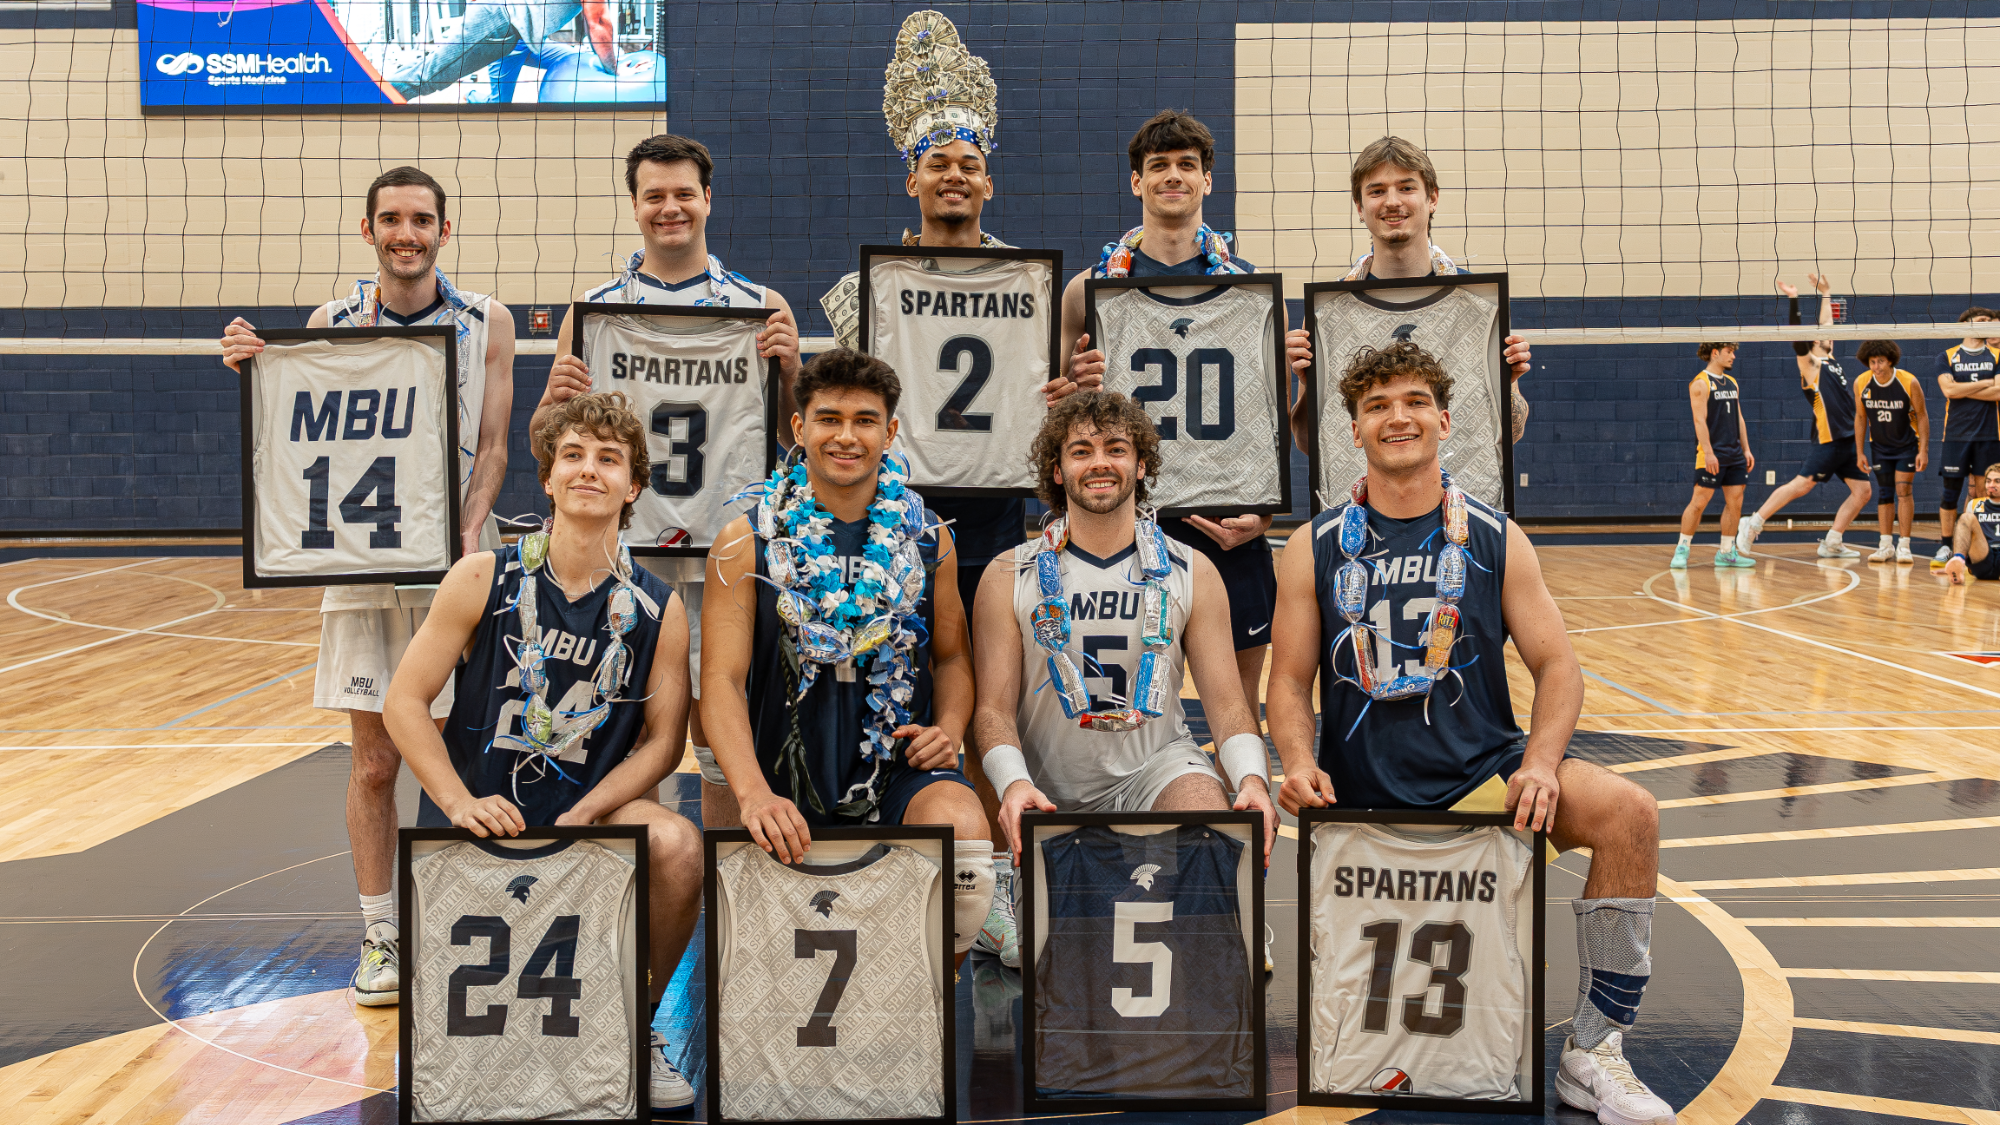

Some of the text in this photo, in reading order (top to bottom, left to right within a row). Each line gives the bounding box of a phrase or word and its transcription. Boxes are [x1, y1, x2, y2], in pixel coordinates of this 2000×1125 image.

[207, 75, 287, 86] Sports Medicine
[900, 289, 1034, 319] SPARTANS
[611, 352, 748, 386] SPARTANS
[934, 334, 994, 433] 2
[1954, 361, 1993, 372] GRACELAND
[290, 387, 416, 441] MBU
[1131, 348, 1235, 441] 20
[1453, 384, 1487, 422] SPARTAN
[1726, 401, 1731, 414] 1
[1865, 400, 1904, 409] GRACELAND
[1877, 410, 1892, 422] 20
[648, 400, 709, 498] 3
[1216, 431, 1252, 466] SPARTAN
[1226, 441, 1262, 477] SPARTAN
[301, 456, 402, 549] 14
[1371, 555, 1437, 585] MBU
[1071, 591, 1140, 620] MBU
[1438, 613, 1456, 627] RITZ
[536, 625, 597, 666] MBU
[344, 687, 379, 697] VOLLEYBALL
[351, 676, 374, 689] MBU
[1083, 635, 1128, 712] 5
[861, 860, 903, 908] SPARTAN
[874, 873, 914, 918] SPARTAN
[1333, 865, 1497, 903] SPARTANS
[516, 891, 561, 935] SPARTAN
[748, 909, 785, 950] SPARTAN
[447, 915, 582, 1038] 24
[859, 943, 901, 988] SPARTAN
[872, 955, 913, 1000] SPARTAN
[1111, 902, 1173, 1018] 5
[1359, 919, 1475, 1038] 13
[730, 975, 774, 1019] SPARTAN
[794, 929, 857, 1047] 7
[884, 967, 925, 1013] SPARTAN
[741, 990, 782, 1032] SPARTAN
[754, 1002, 794, 1044] SPARTAN
[843, 1011, 887, 1055] SPARTAN
[476, 1030, 519, 1075] SPARTAN
[485, 1043, 531, 1087] SPARTAN
[553, 1026, 596, 1070] SPARTAN
[564, 1039, 610, 1085] SPARTAN
[856, 1023, 900, 1067] SPARTAN
[869, 1035, 912, 1080] SPARTAN
[497, 1055, 544, 1101] SPARTAN
[510, 1068, 555, 1113] SPARTAN
[576, 1052, 622, 1097] SPARTAN
[726, 1056, 767, 1098] SPARTAN
[737, 1069, 779, 1112] SPARTAN
[802, 1054, 845, 1097] SPARTAN
[814, 1065, 858, 1109] SPARTAN
[881, 1047, 924, 1092] SPARTAN
[894, 1061, 935, 1104] SPARTAN
